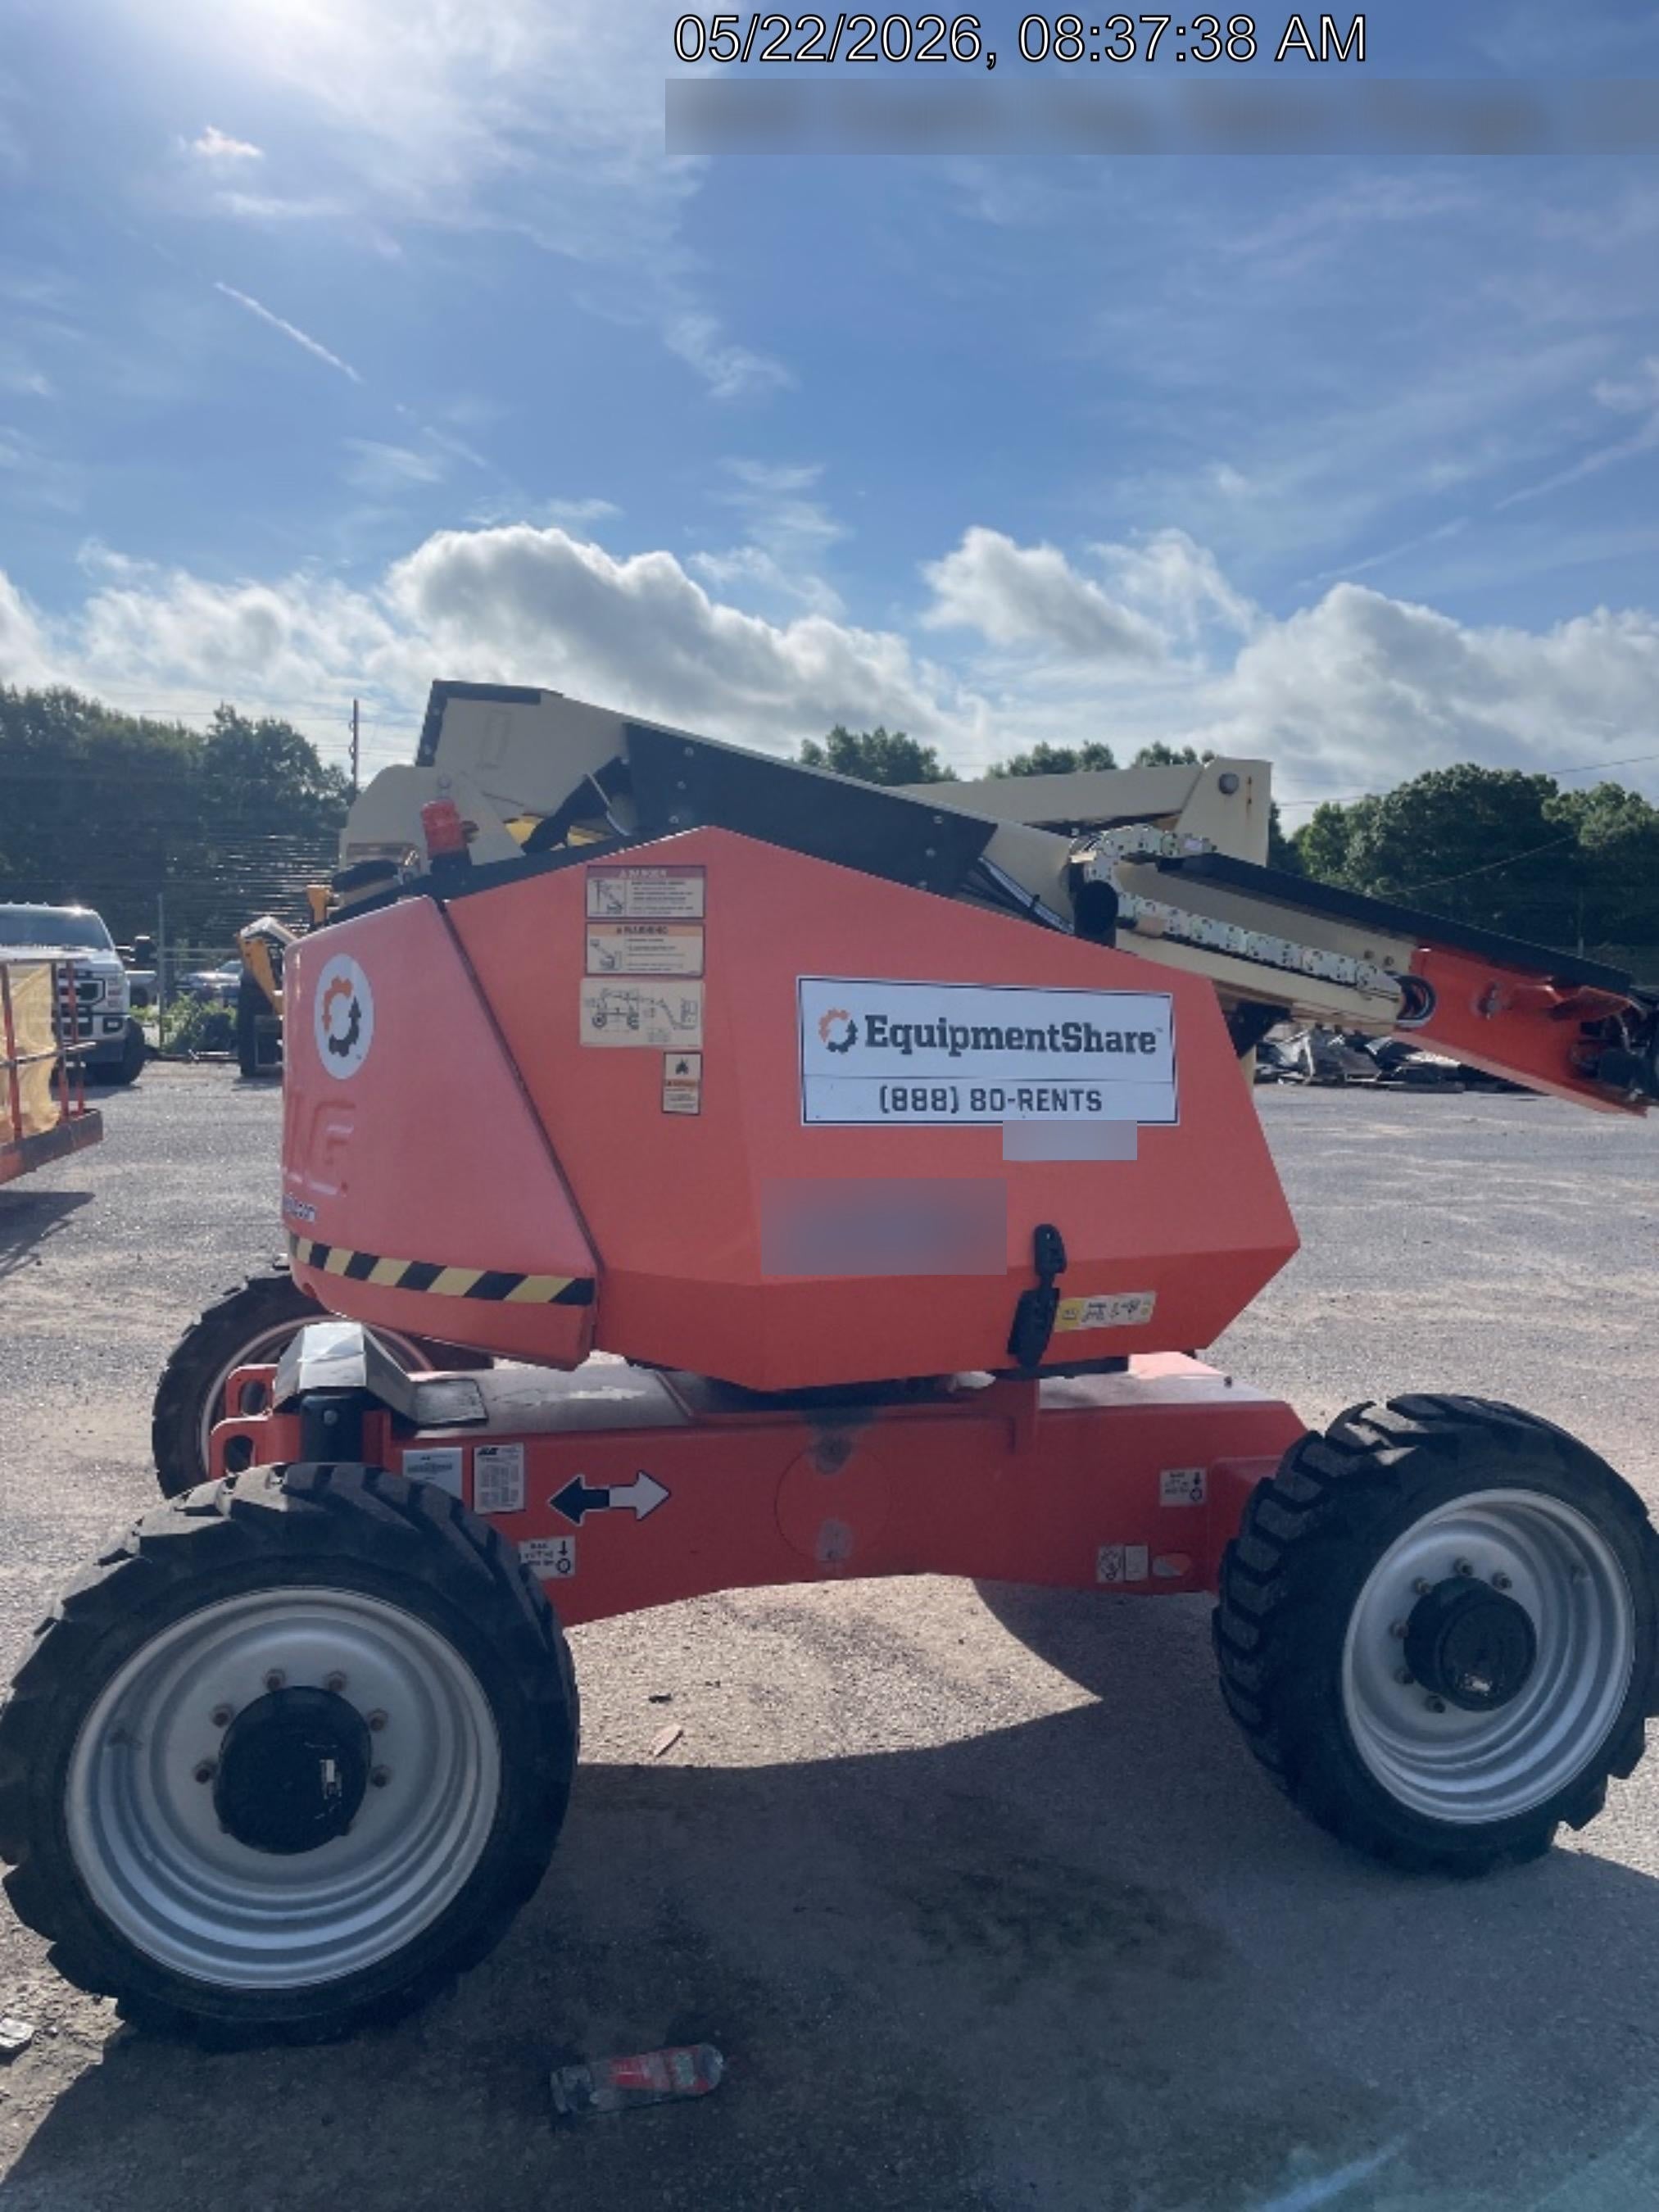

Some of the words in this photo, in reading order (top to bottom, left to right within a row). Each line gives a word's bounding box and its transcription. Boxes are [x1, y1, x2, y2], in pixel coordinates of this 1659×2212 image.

[865, 1014, 1157, 1057] EquipmentShare
[880, 1086, 959, 1114] (888)
[970, 1087, 1103, 1113] 80-RENTS
